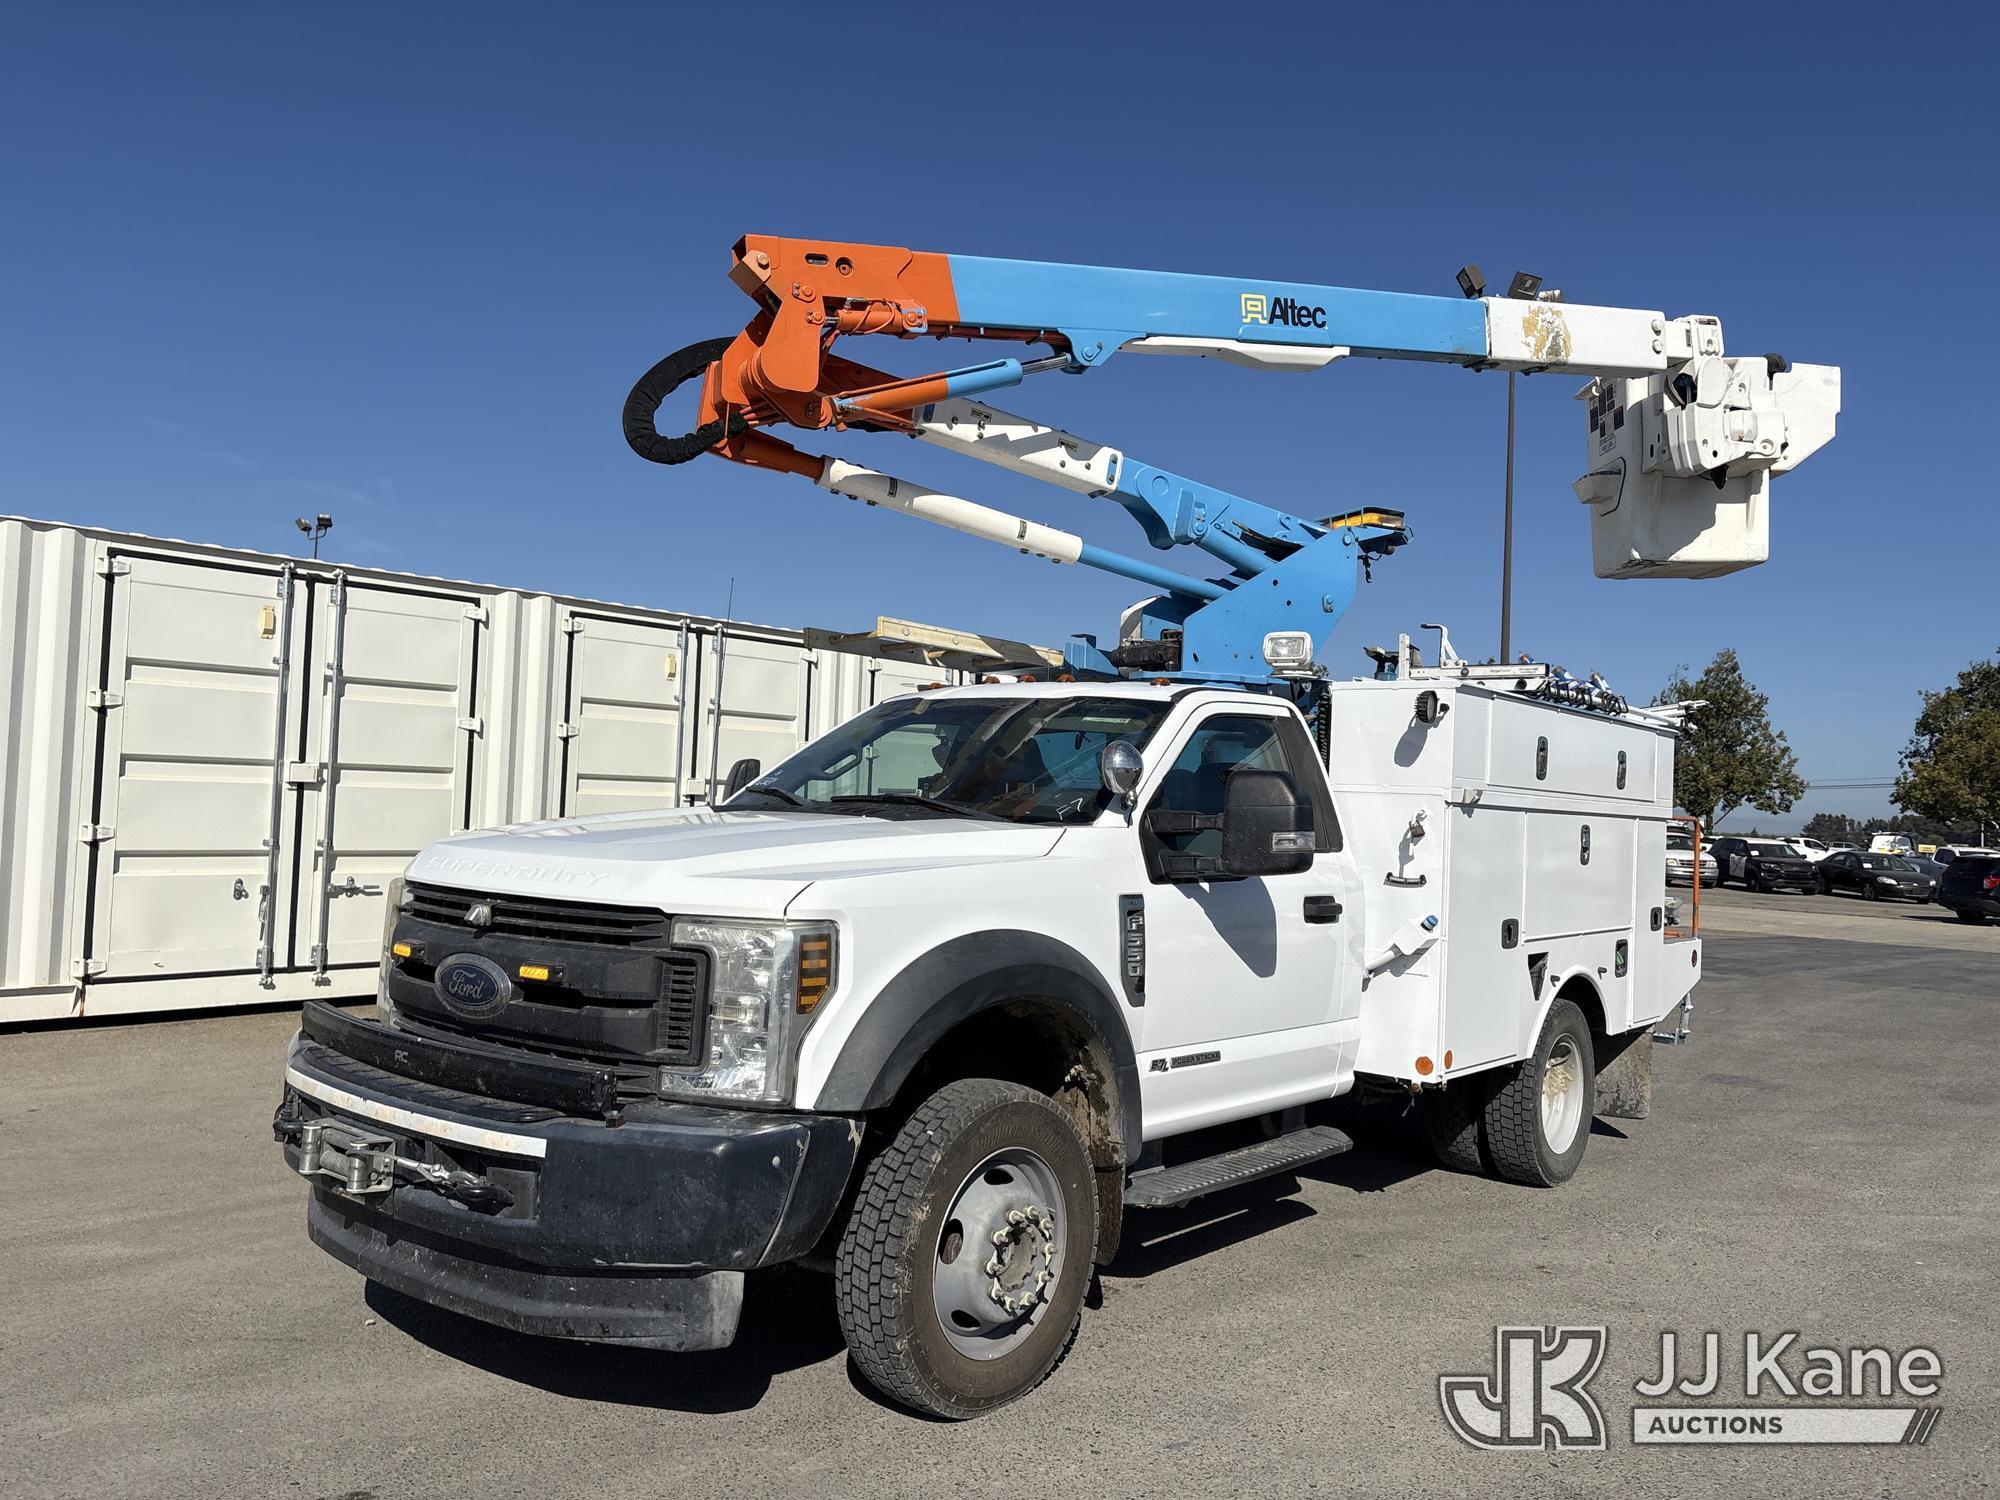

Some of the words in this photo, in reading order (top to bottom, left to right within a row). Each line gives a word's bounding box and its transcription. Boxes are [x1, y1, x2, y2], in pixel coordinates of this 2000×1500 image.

[1268, 296, 1327, 328] Altec
[425, 856, 513, 877] SUPER
[513, 865, 610, 886] DUTY
[1127, 915, 1144, 977] F550
[448, 969, 485, 999] Ford
